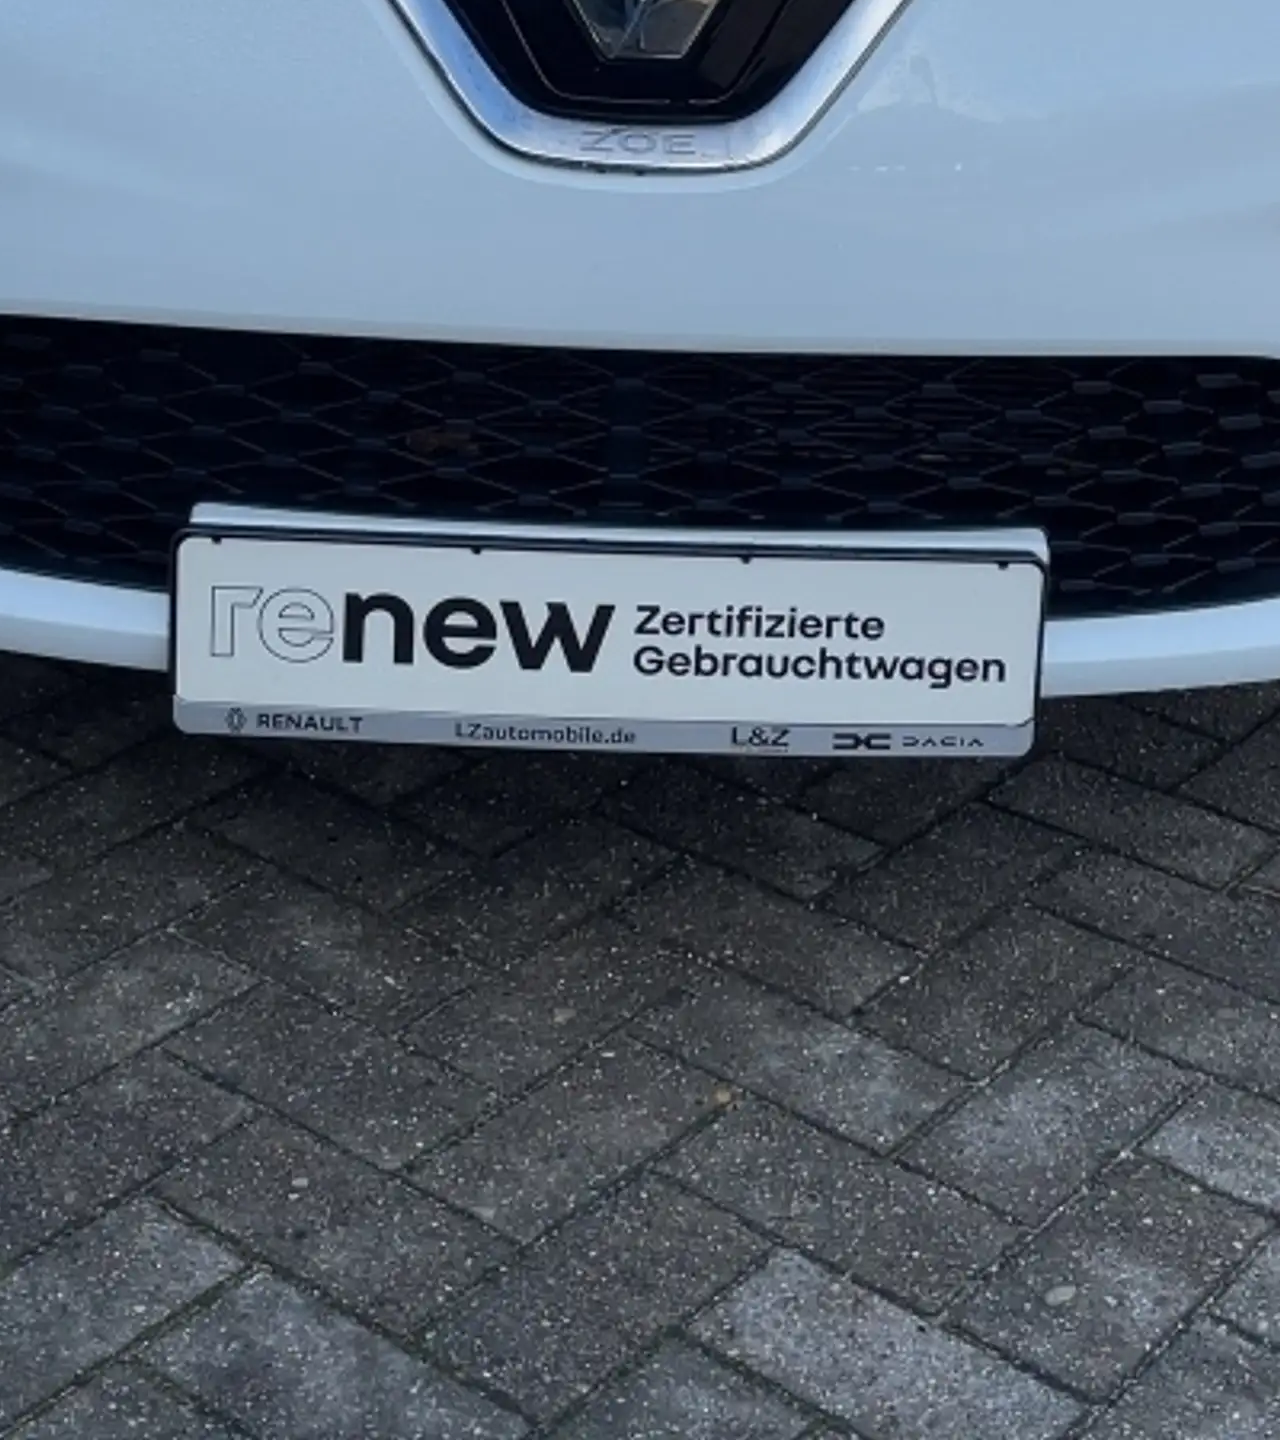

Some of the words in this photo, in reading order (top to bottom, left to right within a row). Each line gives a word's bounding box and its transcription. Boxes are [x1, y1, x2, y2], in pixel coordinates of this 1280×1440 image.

[580, 130, 696, 156] ZOE
[210, 585, 616, 673] renew
[634, 604, 886, 641] Zertifizierte
[633, 644, 1006, 689] Gebrauchtwagen
[256, 713, 364, 734] RENAULT
[455, 721, 636, 745] LZautomobile.de
[731, 726, 790, 747] L&Z
[901, 735, 984, 748] DACIA
